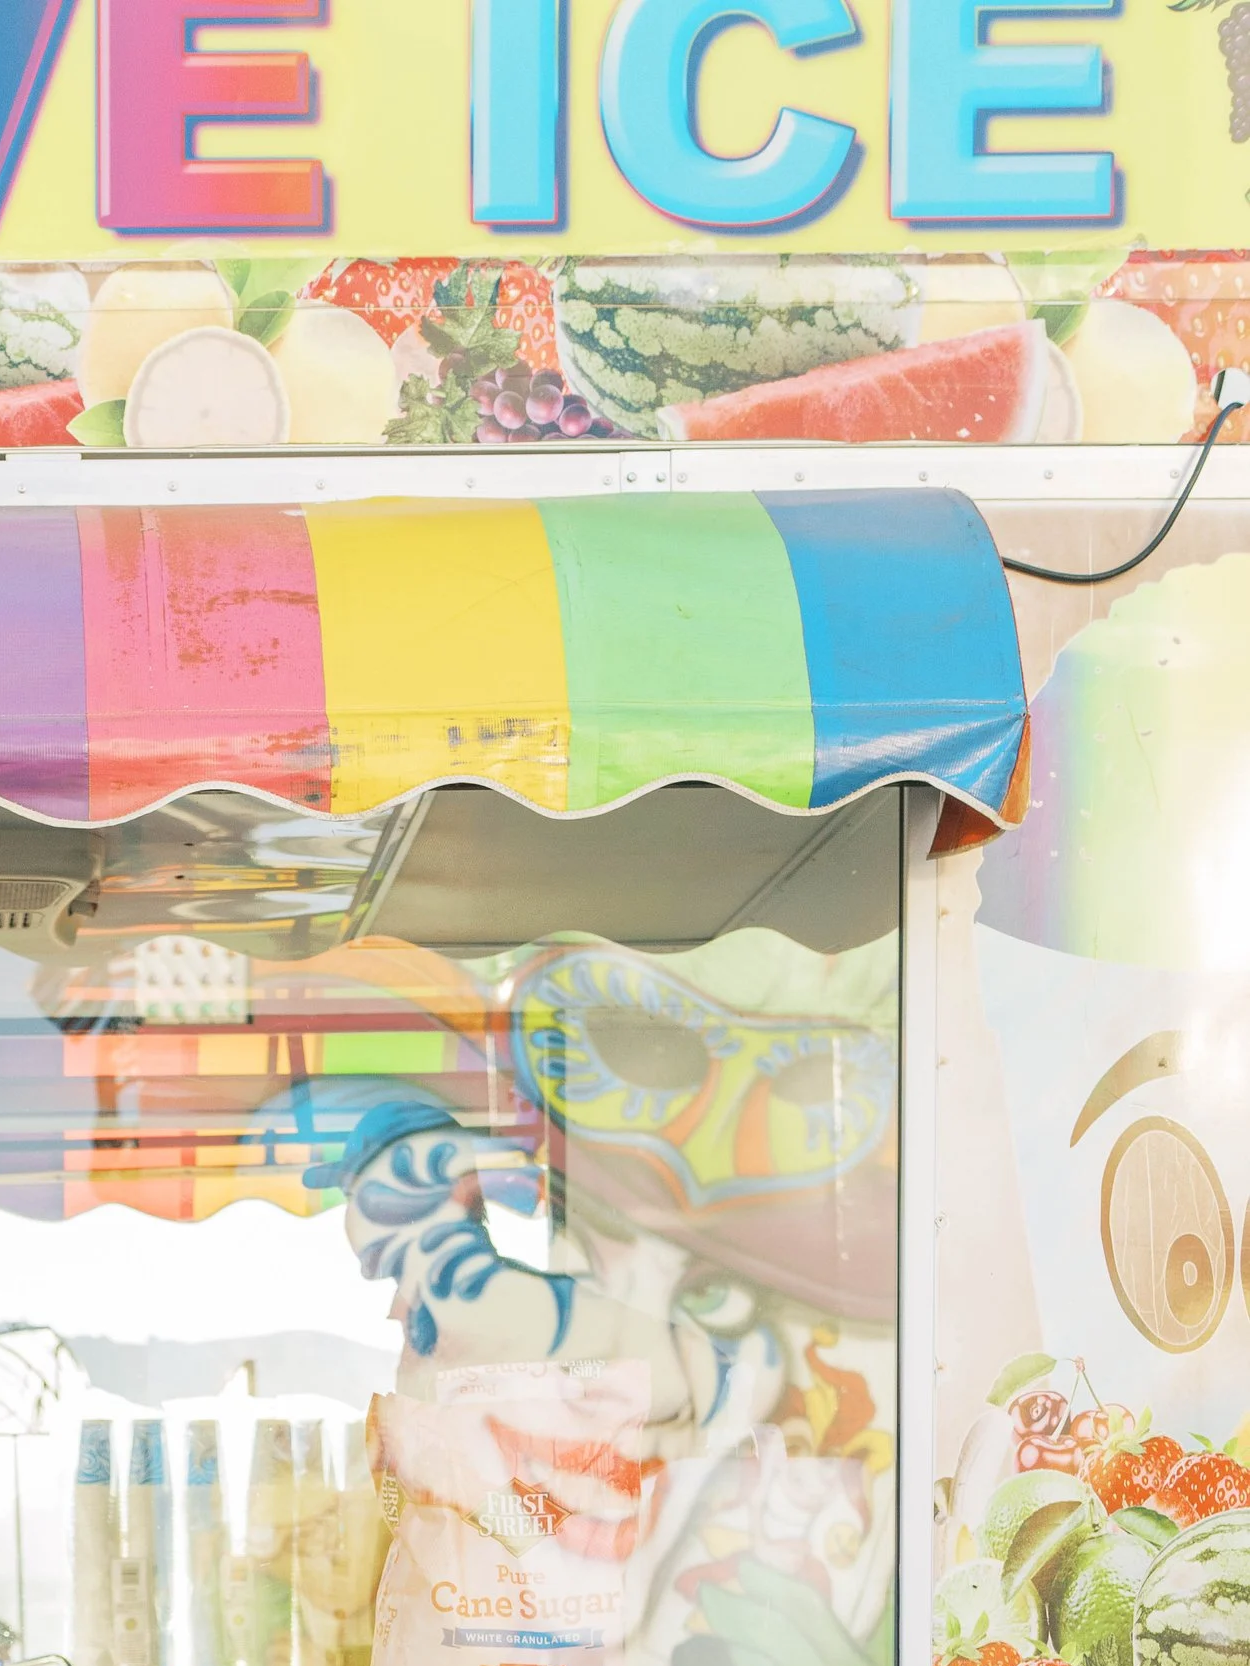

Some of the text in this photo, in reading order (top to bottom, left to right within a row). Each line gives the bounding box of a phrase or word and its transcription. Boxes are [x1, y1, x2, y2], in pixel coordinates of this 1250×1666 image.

[467, 0, 1121, 236] ICE
[486, 1491, 549, 1516] FIRST
[478, 1514, 557, 1537] STREET
[496, 1564, 547, 1586] Pure
[431, 1581, 621, 1626] Cane Sugar
[465, 1632, 581, 1645] WHITE GRANULATED
